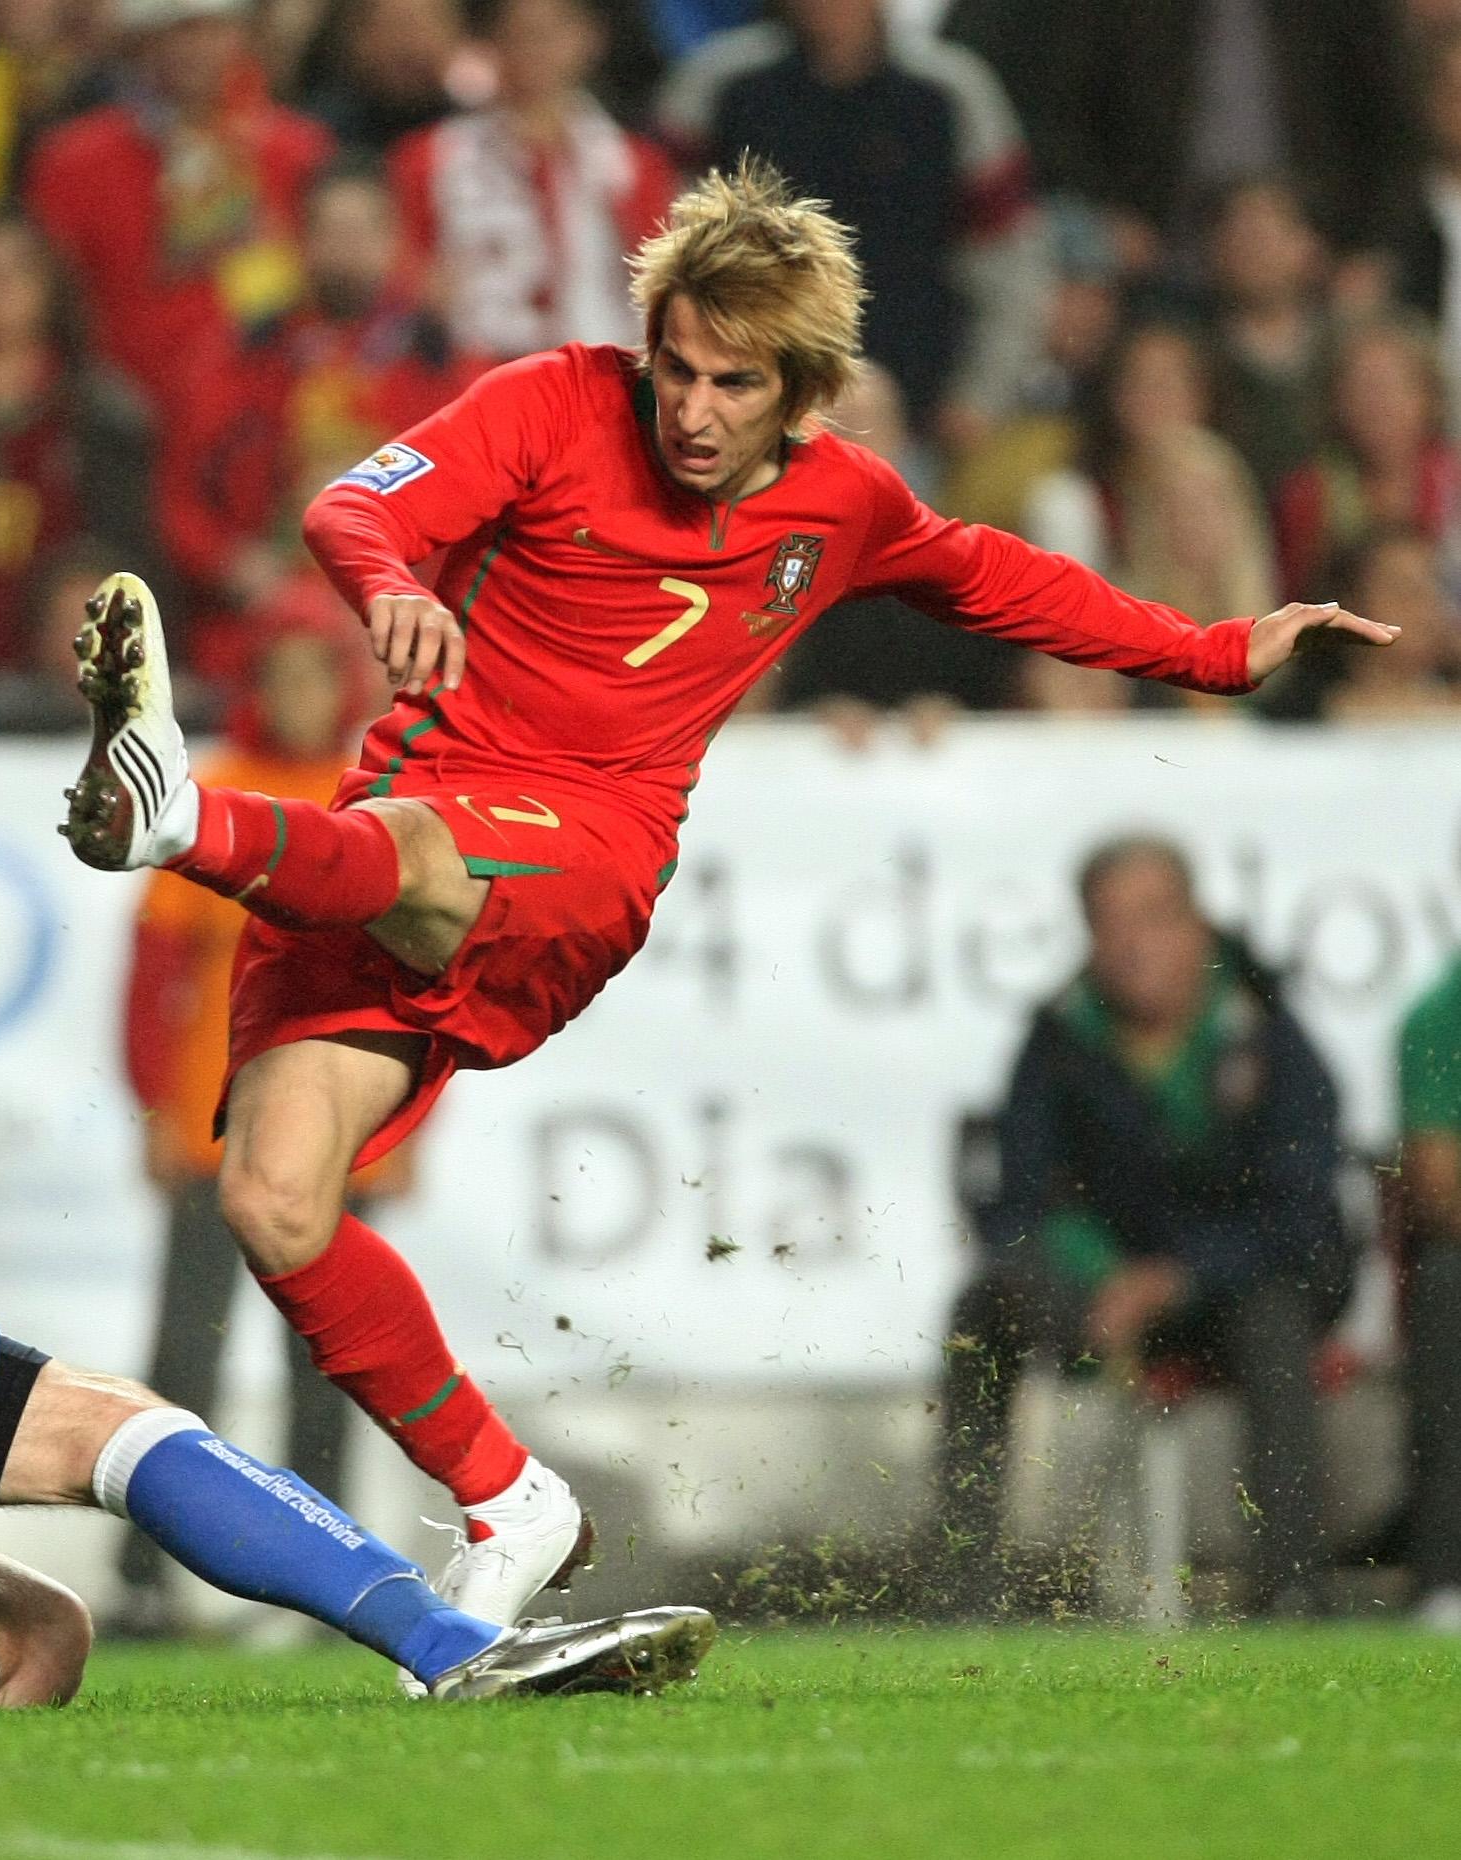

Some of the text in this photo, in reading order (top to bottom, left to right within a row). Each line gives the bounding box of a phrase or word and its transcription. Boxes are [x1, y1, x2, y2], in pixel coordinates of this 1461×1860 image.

[622, 576, 710, 668] 7
[488, 794, 561, 829] 7
[531, 1086, 859, 1268] Dia
[198, 1438, 368, 1551] Bosnia and Herzegovina
